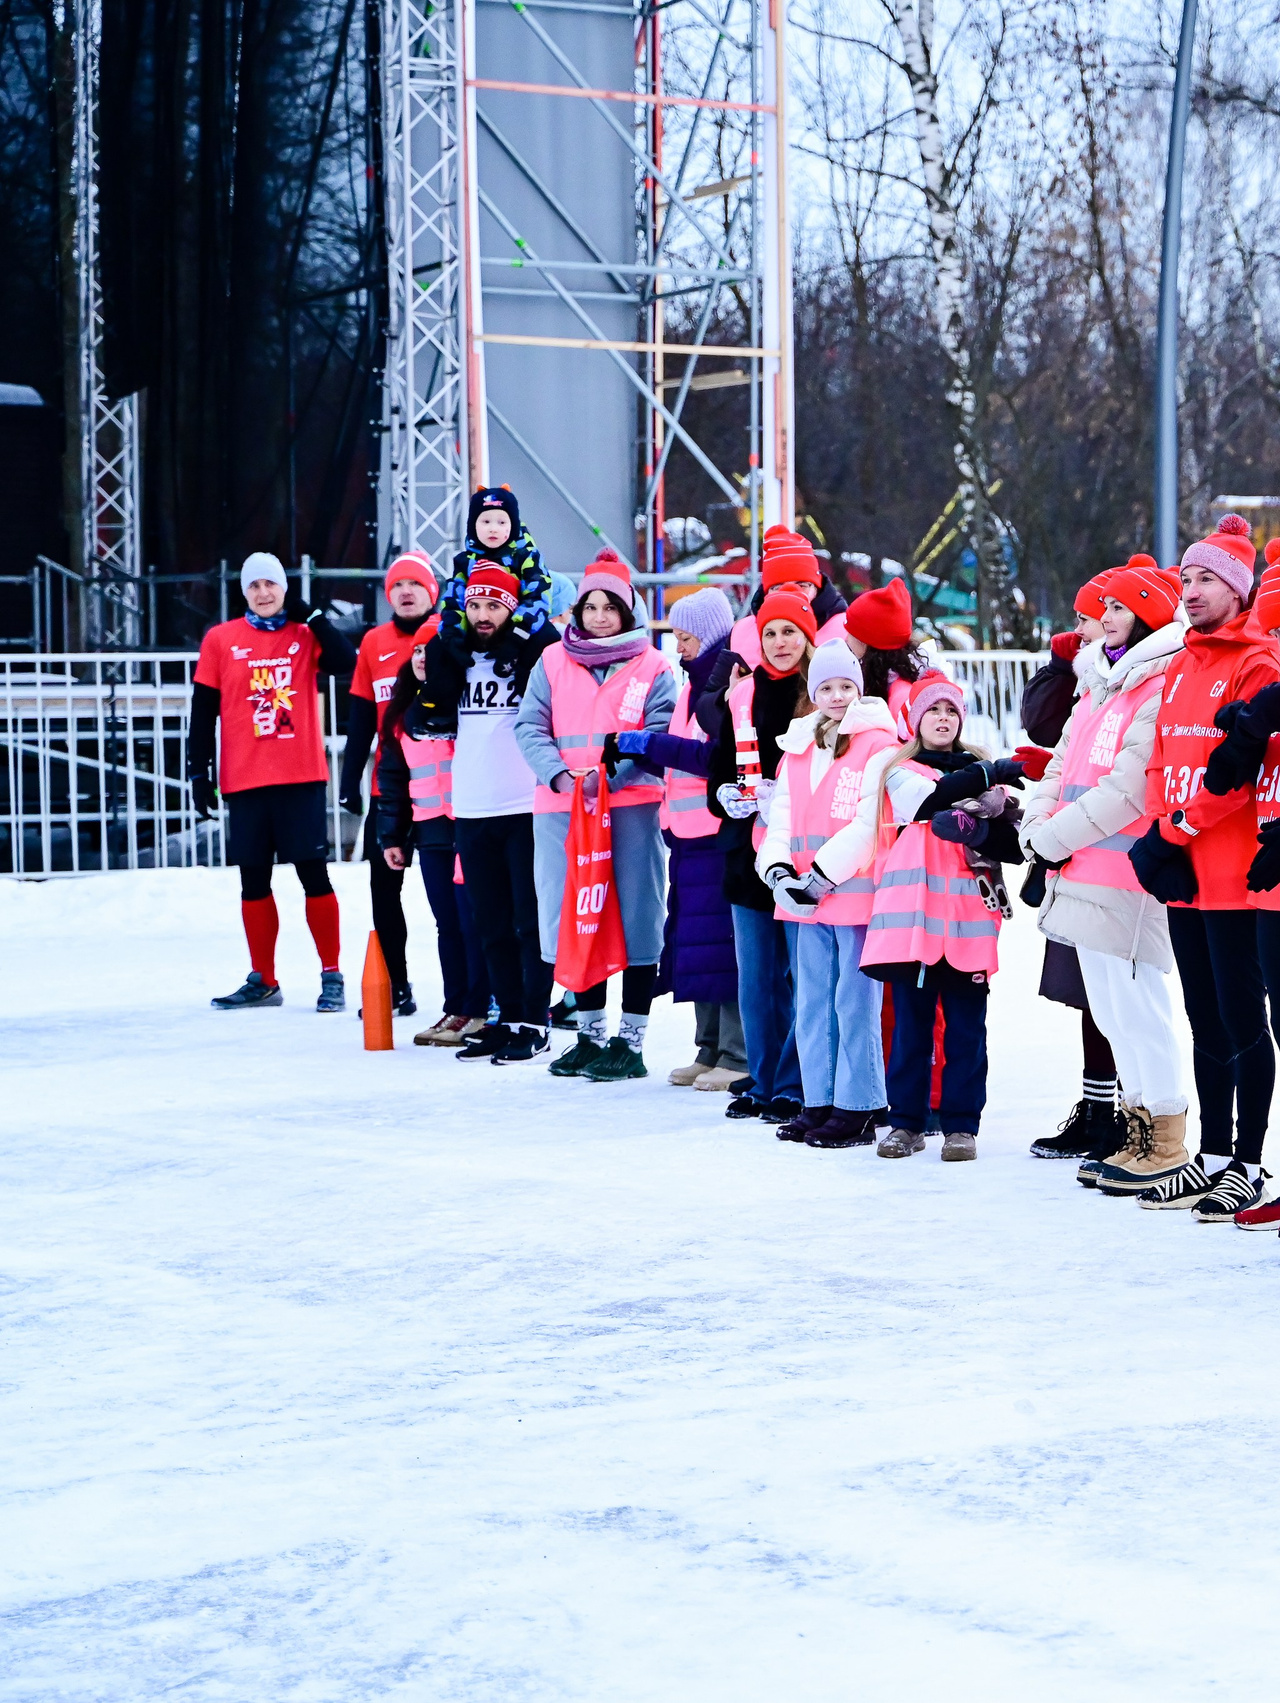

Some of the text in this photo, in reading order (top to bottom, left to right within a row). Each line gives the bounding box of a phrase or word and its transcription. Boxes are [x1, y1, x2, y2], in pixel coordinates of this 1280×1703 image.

[628, 677, 650, 698] Sat
[622, 691, 646, 711] 9AM
[1100, 709, 1124, 733] Sat
[1093, 730, 1119, 751] 9AM
[1088, 746, 1115, 768] 5KM
[837, 766, 863, 790] Sat
[832, 786, 860, 805] 9AM
